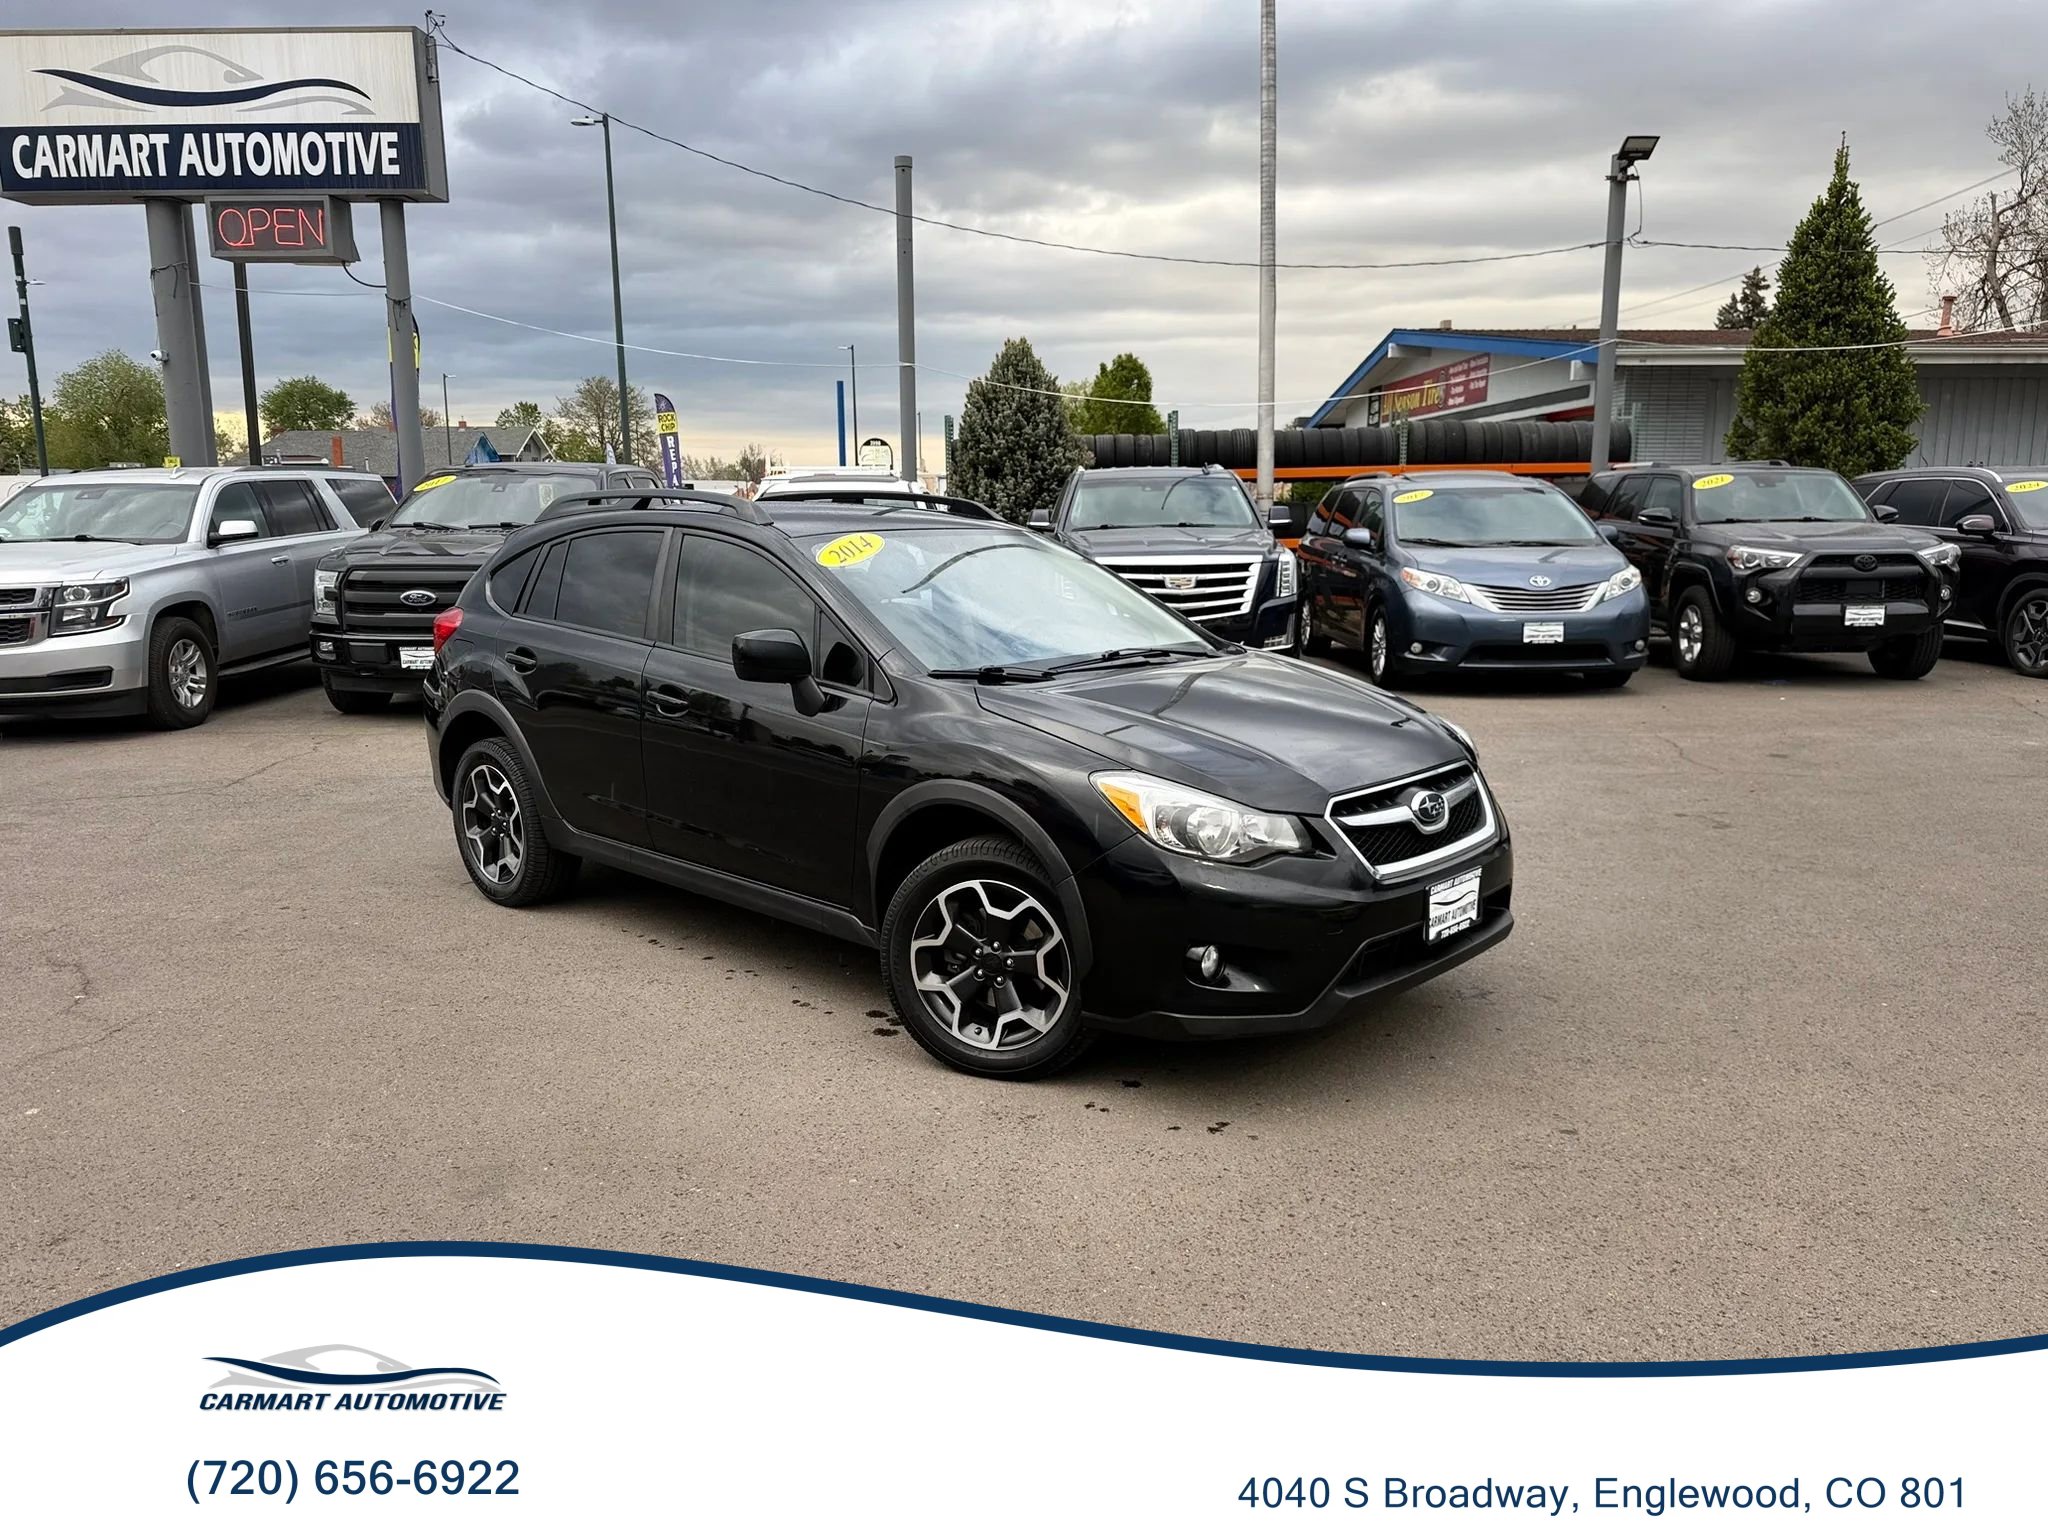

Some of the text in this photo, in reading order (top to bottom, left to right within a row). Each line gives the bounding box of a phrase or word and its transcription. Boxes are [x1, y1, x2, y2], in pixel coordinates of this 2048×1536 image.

[12, 131, 401, 179] CARMART AUTOMOTIVE
[218, 208, 325, 248] OPEN
[657, 413, 676, 424] ROCK
[660, 422, 676, 432] CHIP
[666, 435, 680, 489] REPA
[828, 535, 873, 563] 2014
